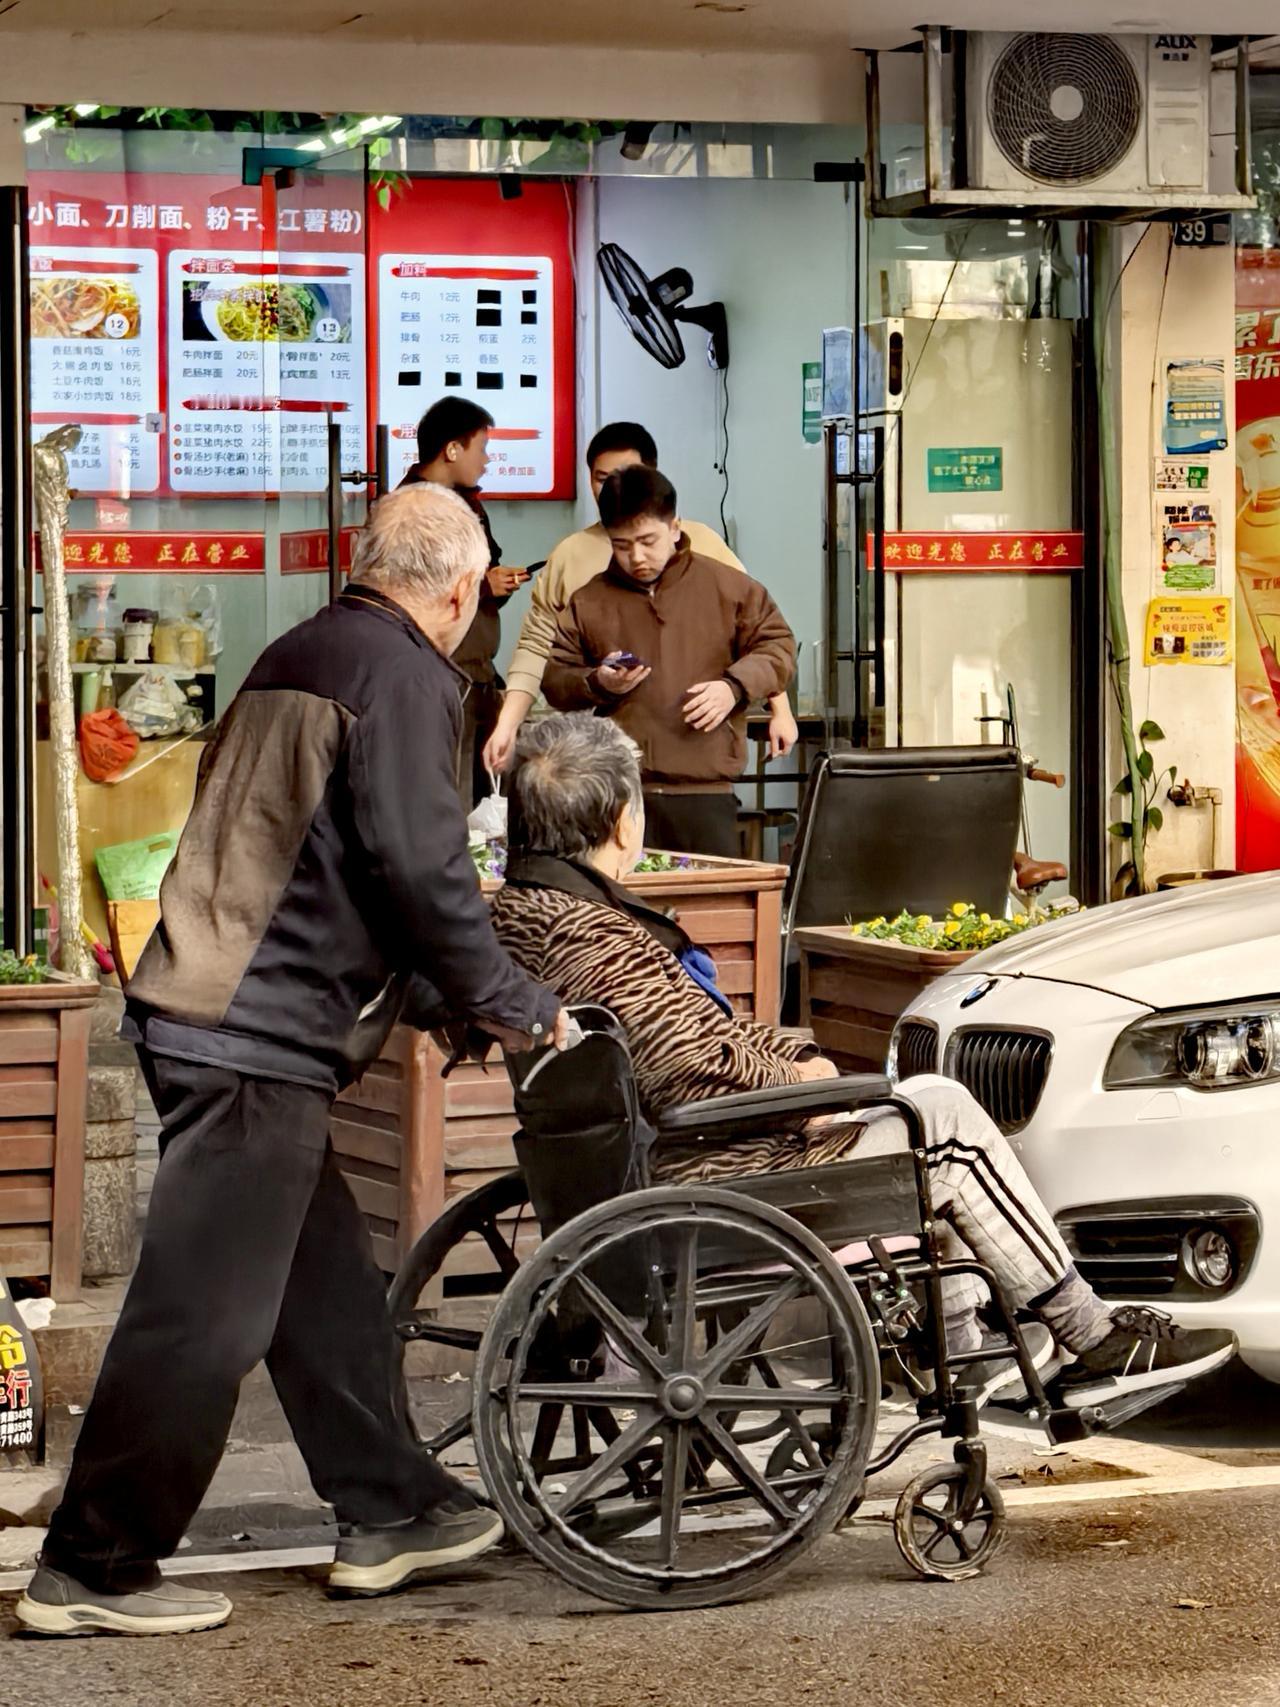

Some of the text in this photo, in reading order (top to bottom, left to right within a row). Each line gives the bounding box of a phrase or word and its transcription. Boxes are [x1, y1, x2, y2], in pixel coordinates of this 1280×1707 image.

[1181, 220, 1206, 242] 39
[157, 541, 250, 564] 正在营业
[988, 541, 1069, 562] 正在营业
